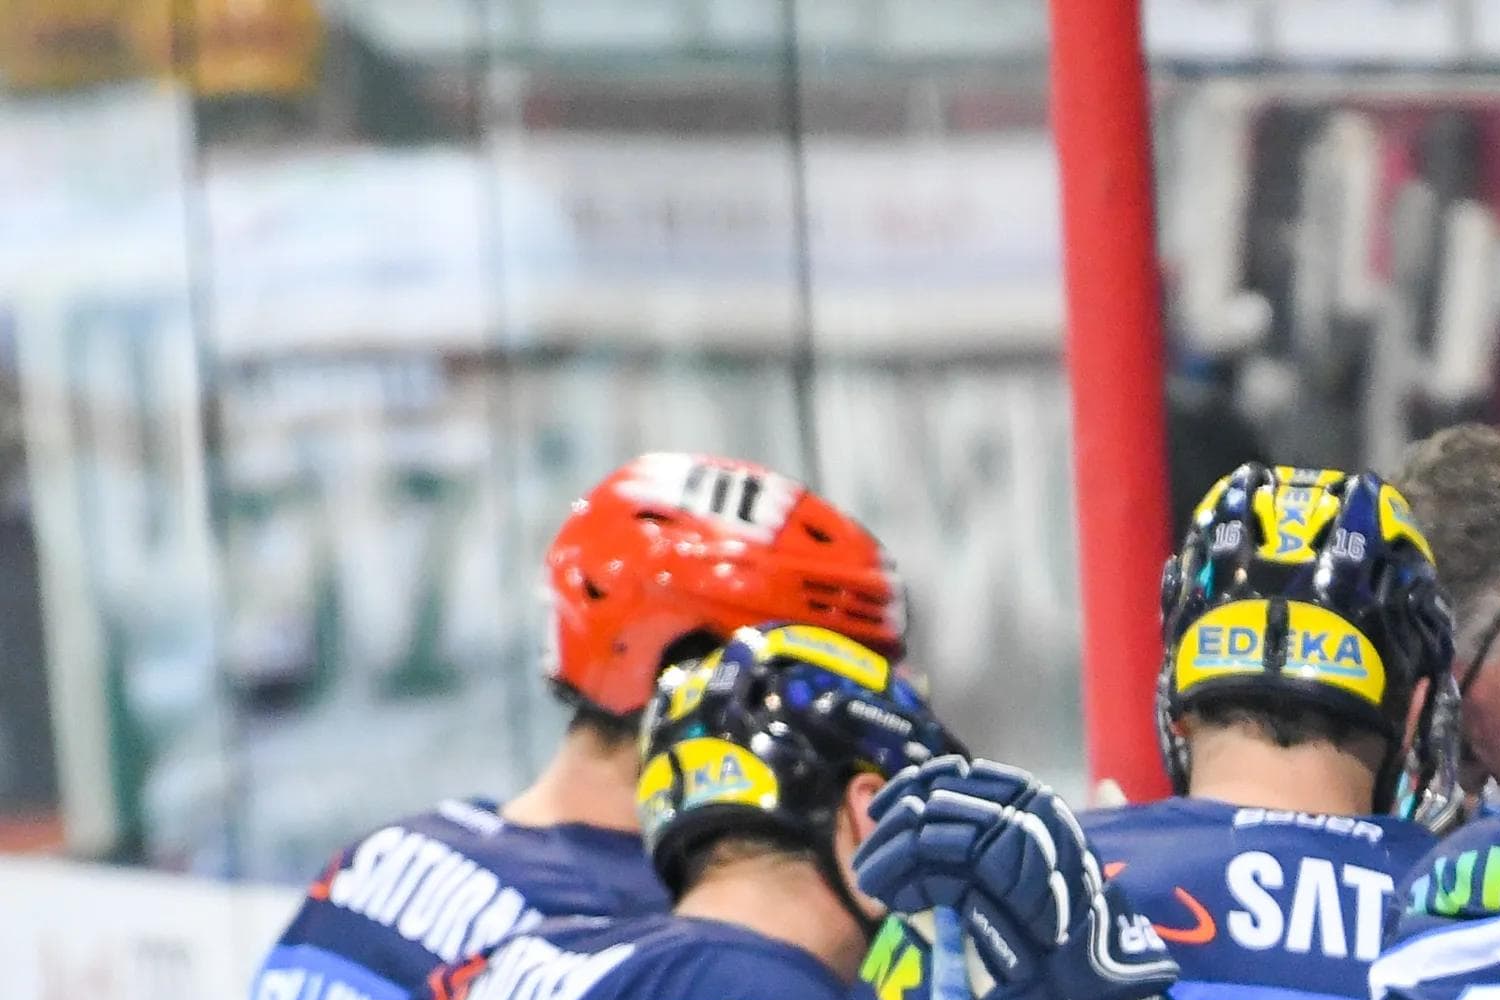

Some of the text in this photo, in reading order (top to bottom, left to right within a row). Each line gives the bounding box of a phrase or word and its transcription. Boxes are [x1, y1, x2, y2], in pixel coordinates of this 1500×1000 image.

[1213, 520, 1243, 553] 16
[1333, 528, 1367, 562] 16
[1226, 851, 1395, 962] SAT
